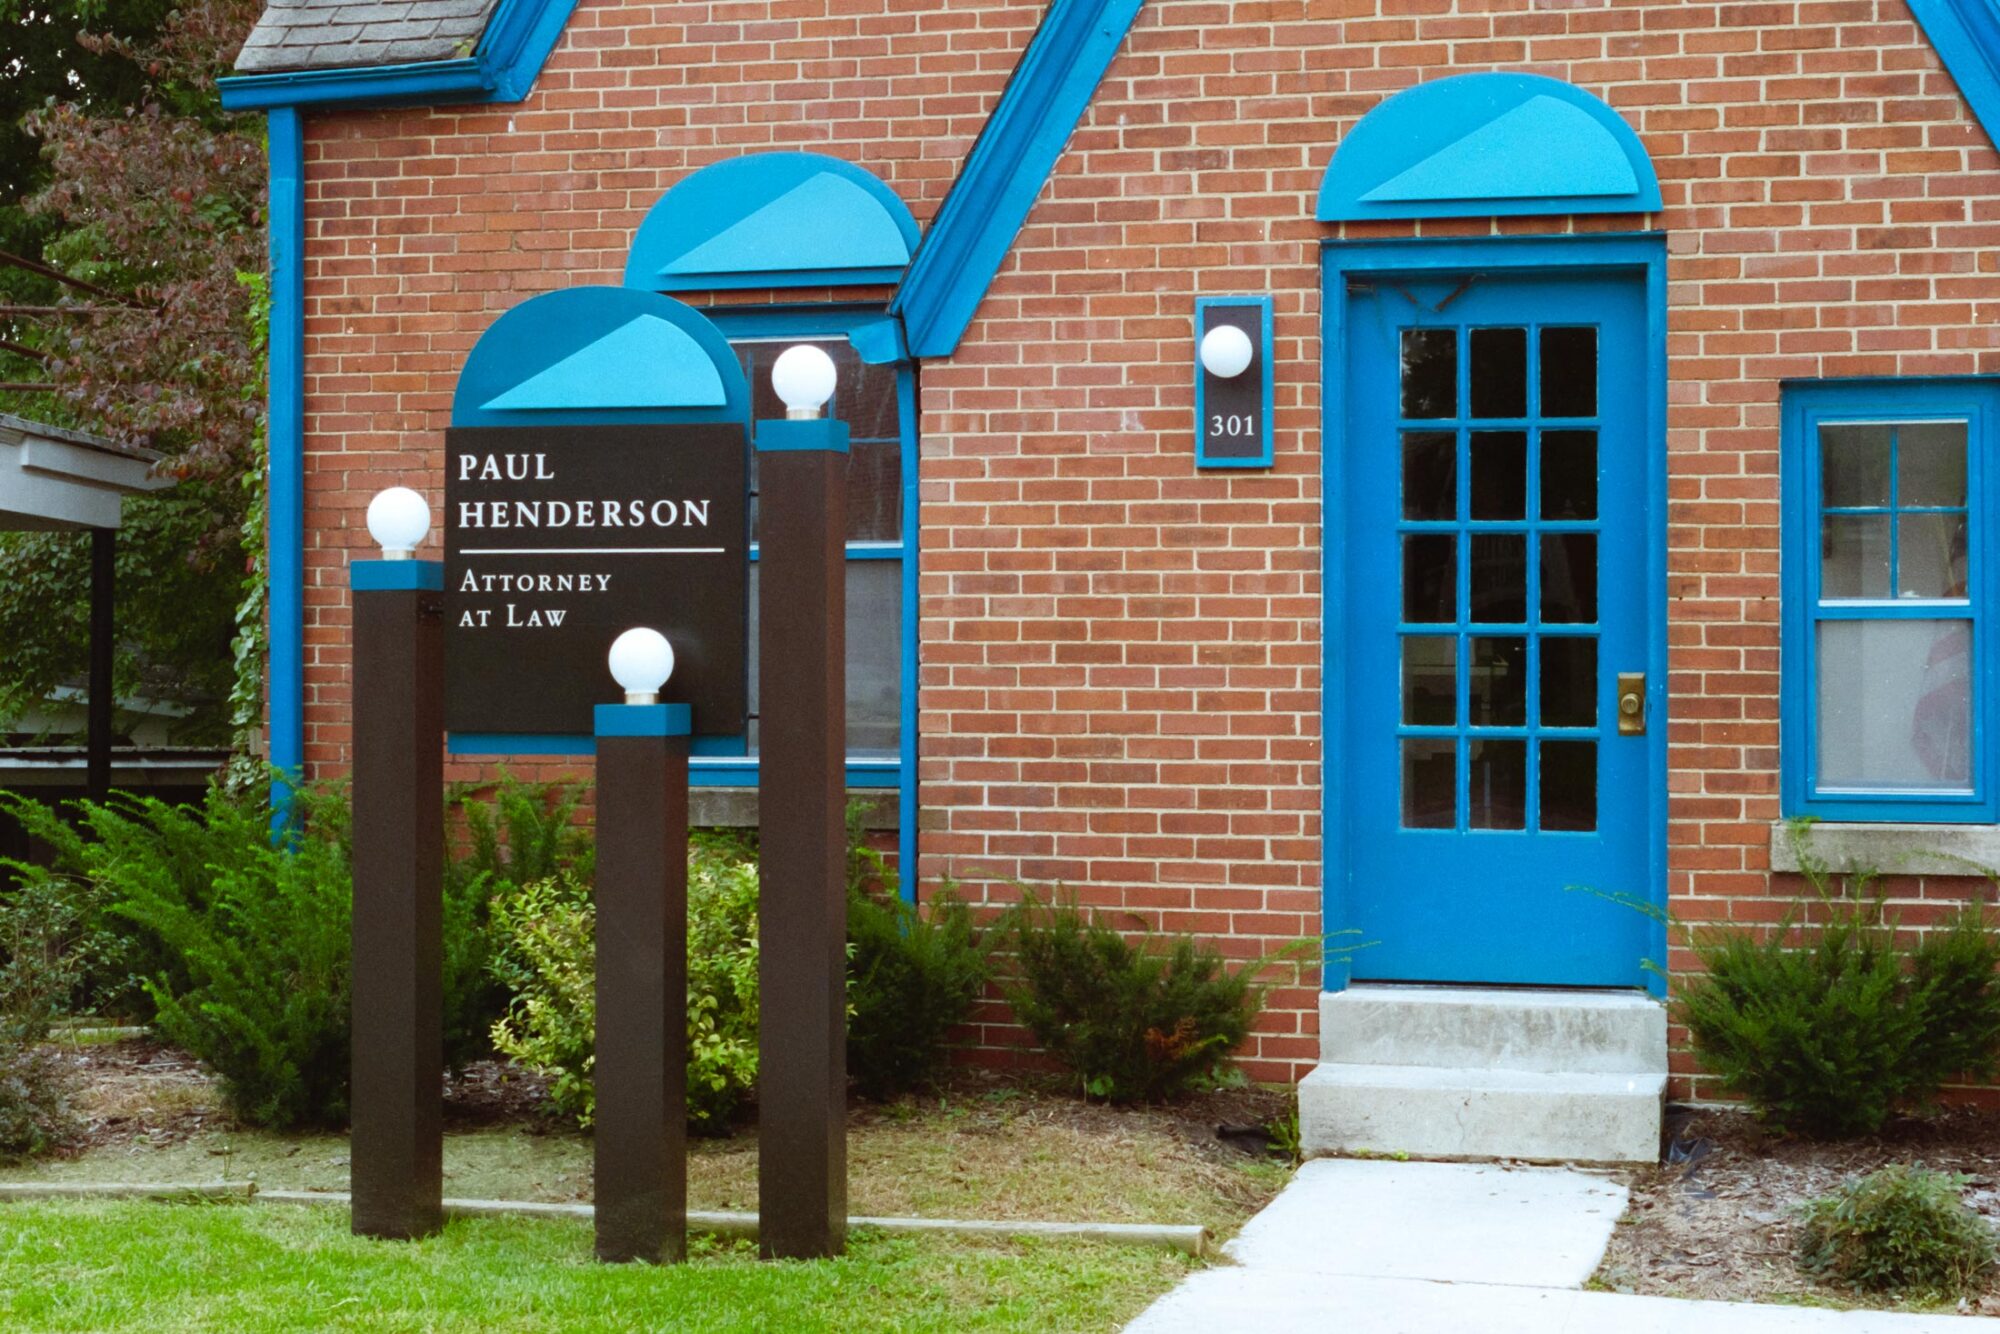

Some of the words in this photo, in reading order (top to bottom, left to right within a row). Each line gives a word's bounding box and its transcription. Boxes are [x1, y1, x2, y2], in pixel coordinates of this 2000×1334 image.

[1209, 414, 1255, 437] 301
[458, 453, 555, 481] PAUL
[458, 499, 711, 529] HENDERSON
[459, 568, 612, 592] ATTORNEY
[506, 603, 567, 627] LAW
